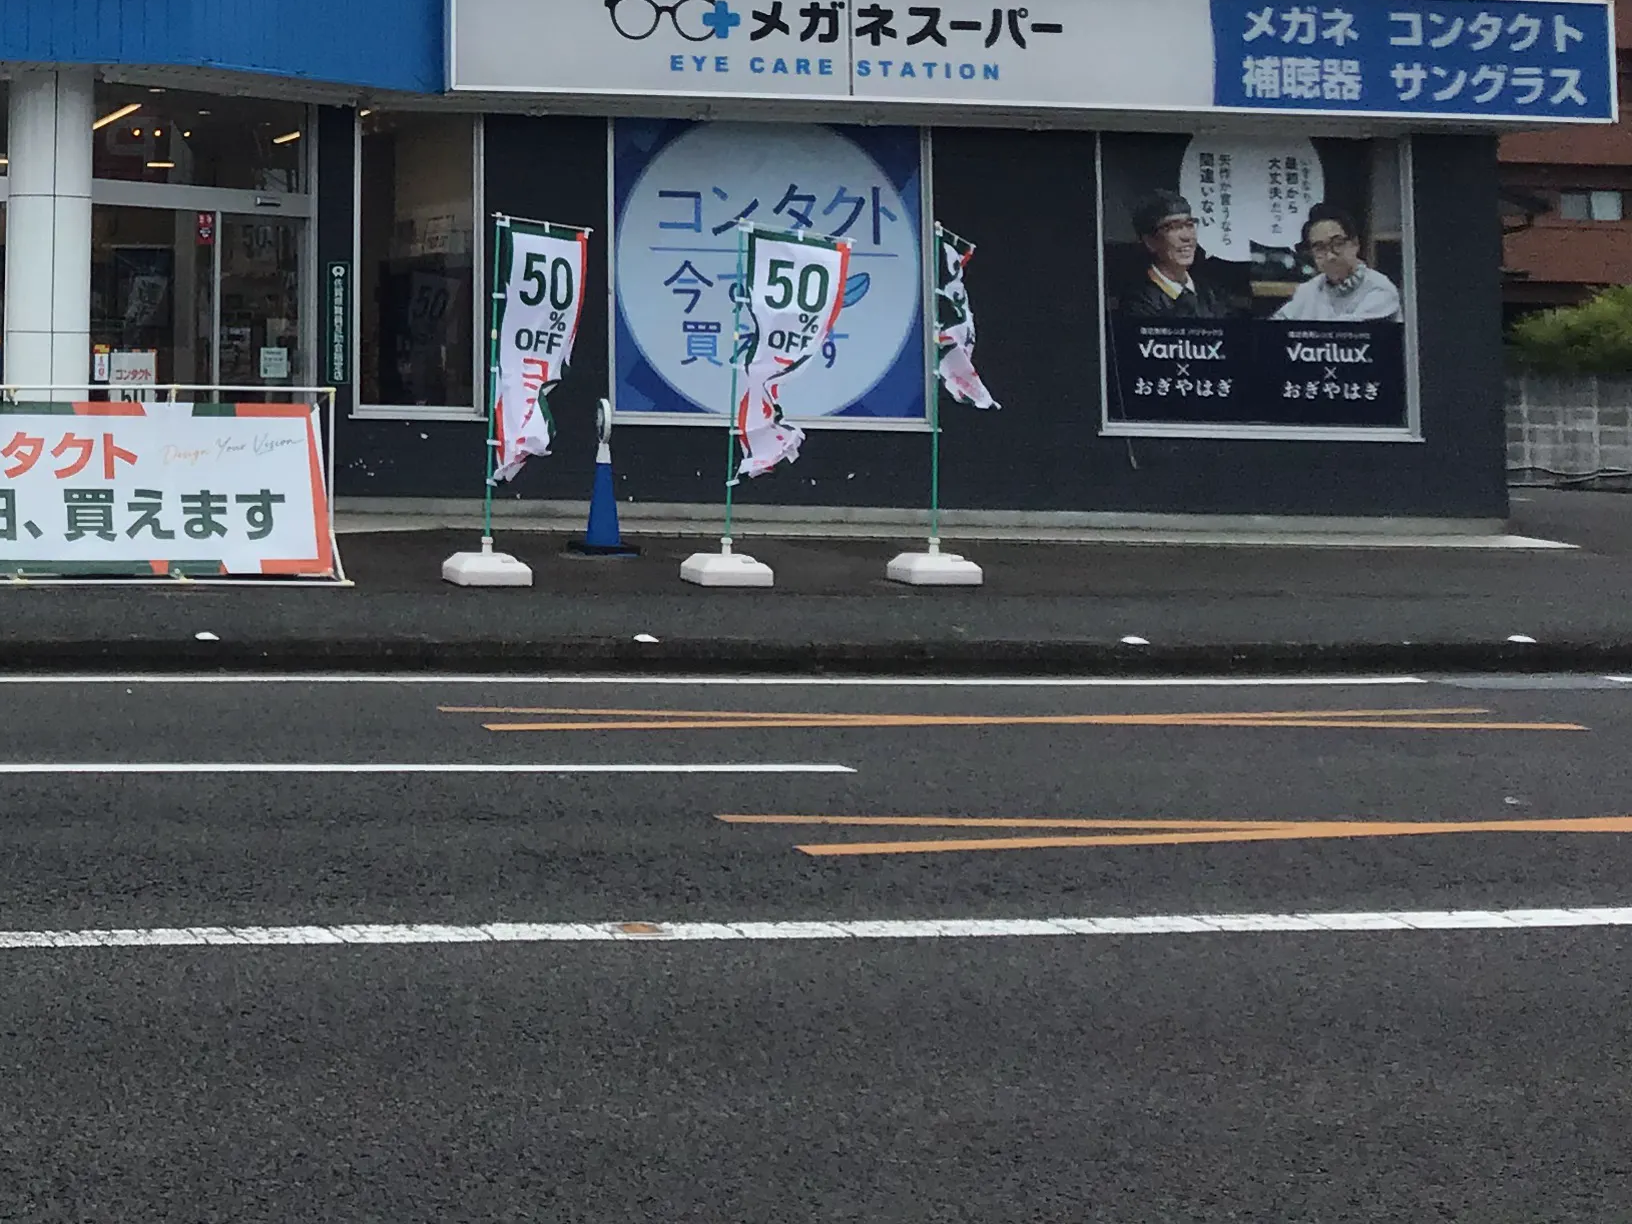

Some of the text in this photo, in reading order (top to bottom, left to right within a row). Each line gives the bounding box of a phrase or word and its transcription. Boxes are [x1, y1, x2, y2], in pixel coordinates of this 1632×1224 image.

[749, 1, 1062, 49] メガネスーパー
[1242, 6, 1584, 54] メガネ コンタクト
[670, 54, 1000, 81] EYE CARE STATION
[1242, 56, 1587, 106] 補聴器 サングラス
[658, 183, 897, 246] コンタクト
[519, 252, 574, 311] 50
[765, 259, 829, 313] 50
[515, 328, 563, 354] OFF
[1135, 377, 1233, 397] おぎやはぎ
[1283, 380, 1381, 400] おぎやはぎ
